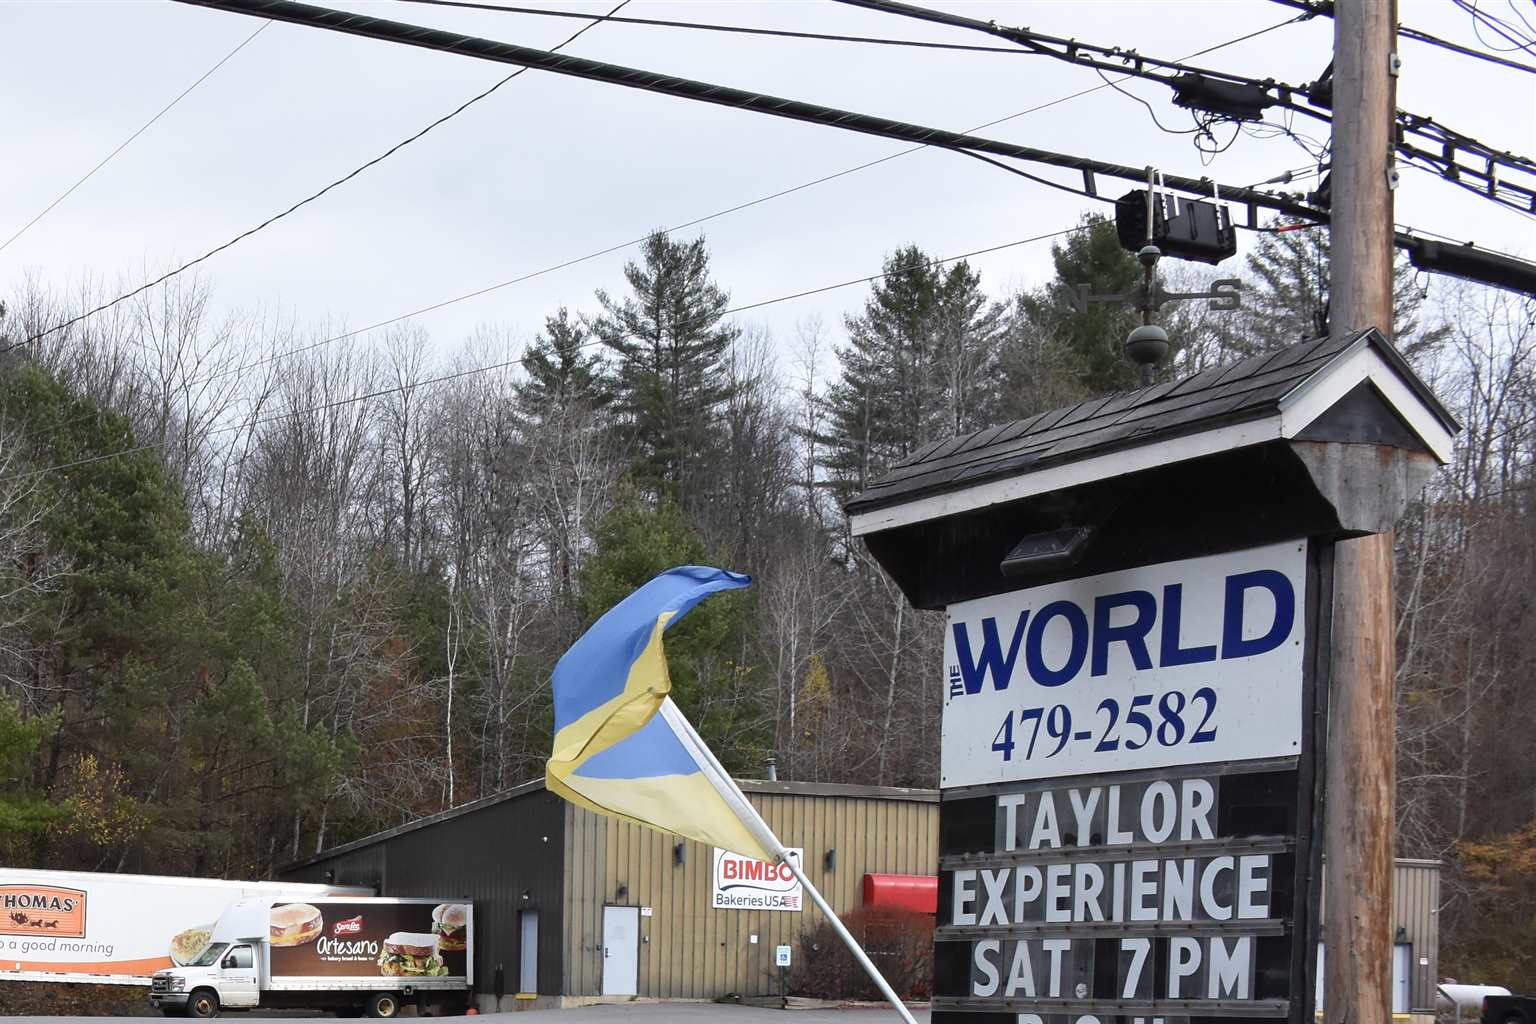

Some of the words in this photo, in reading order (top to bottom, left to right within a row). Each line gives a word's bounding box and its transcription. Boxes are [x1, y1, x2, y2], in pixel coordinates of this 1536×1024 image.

[952, 569, 1296, 696] WORLD
[949, 665, 964, 700] THE
[991, 687, 1218, 761] 479-2582
[998, 778, 1215, 851] TAYLOR
[716, 893, 764, 906] Bakeries
[765, 895, 786, 907] USA
[723, 860, 795, 881] BIMBO
[952, 855, 1269, 926] EXPERIENCE
[9, 941, 18, 950] a
[21, 939, 57, 953] good
[60, 942, 114, 957] morning
[973, 939, 1089, 998] SAT.
